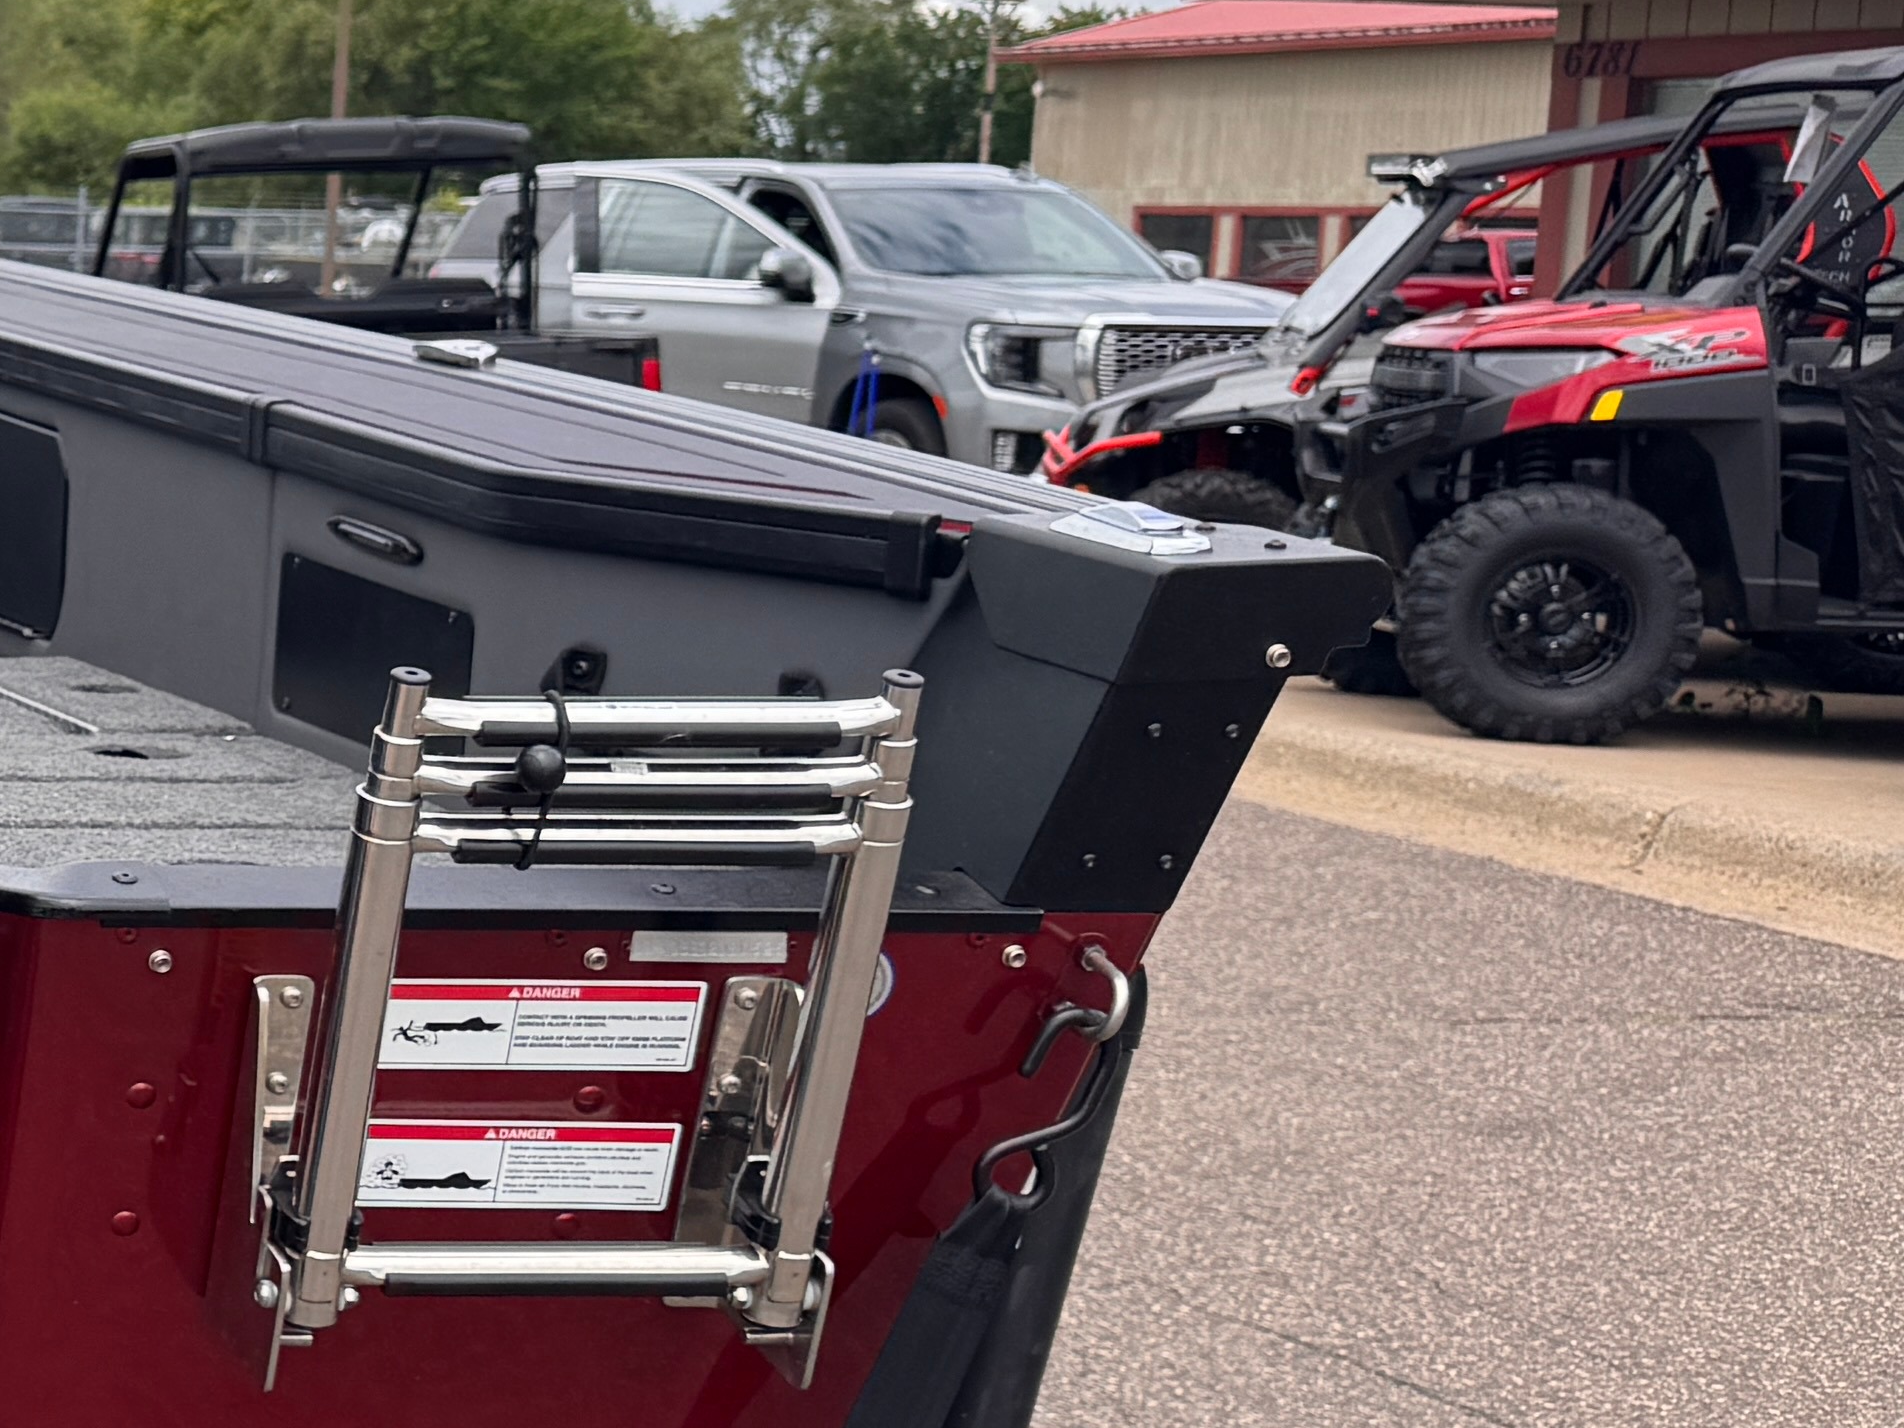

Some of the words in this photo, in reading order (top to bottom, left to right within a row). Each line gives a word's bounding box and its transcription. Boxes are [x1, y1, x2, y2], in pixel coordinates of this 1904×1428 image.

[1564, 40, 1643, 77] 6781
[523, 987, 580, 999] DANGER
[498, 1128, 556, 1140] DANGER
